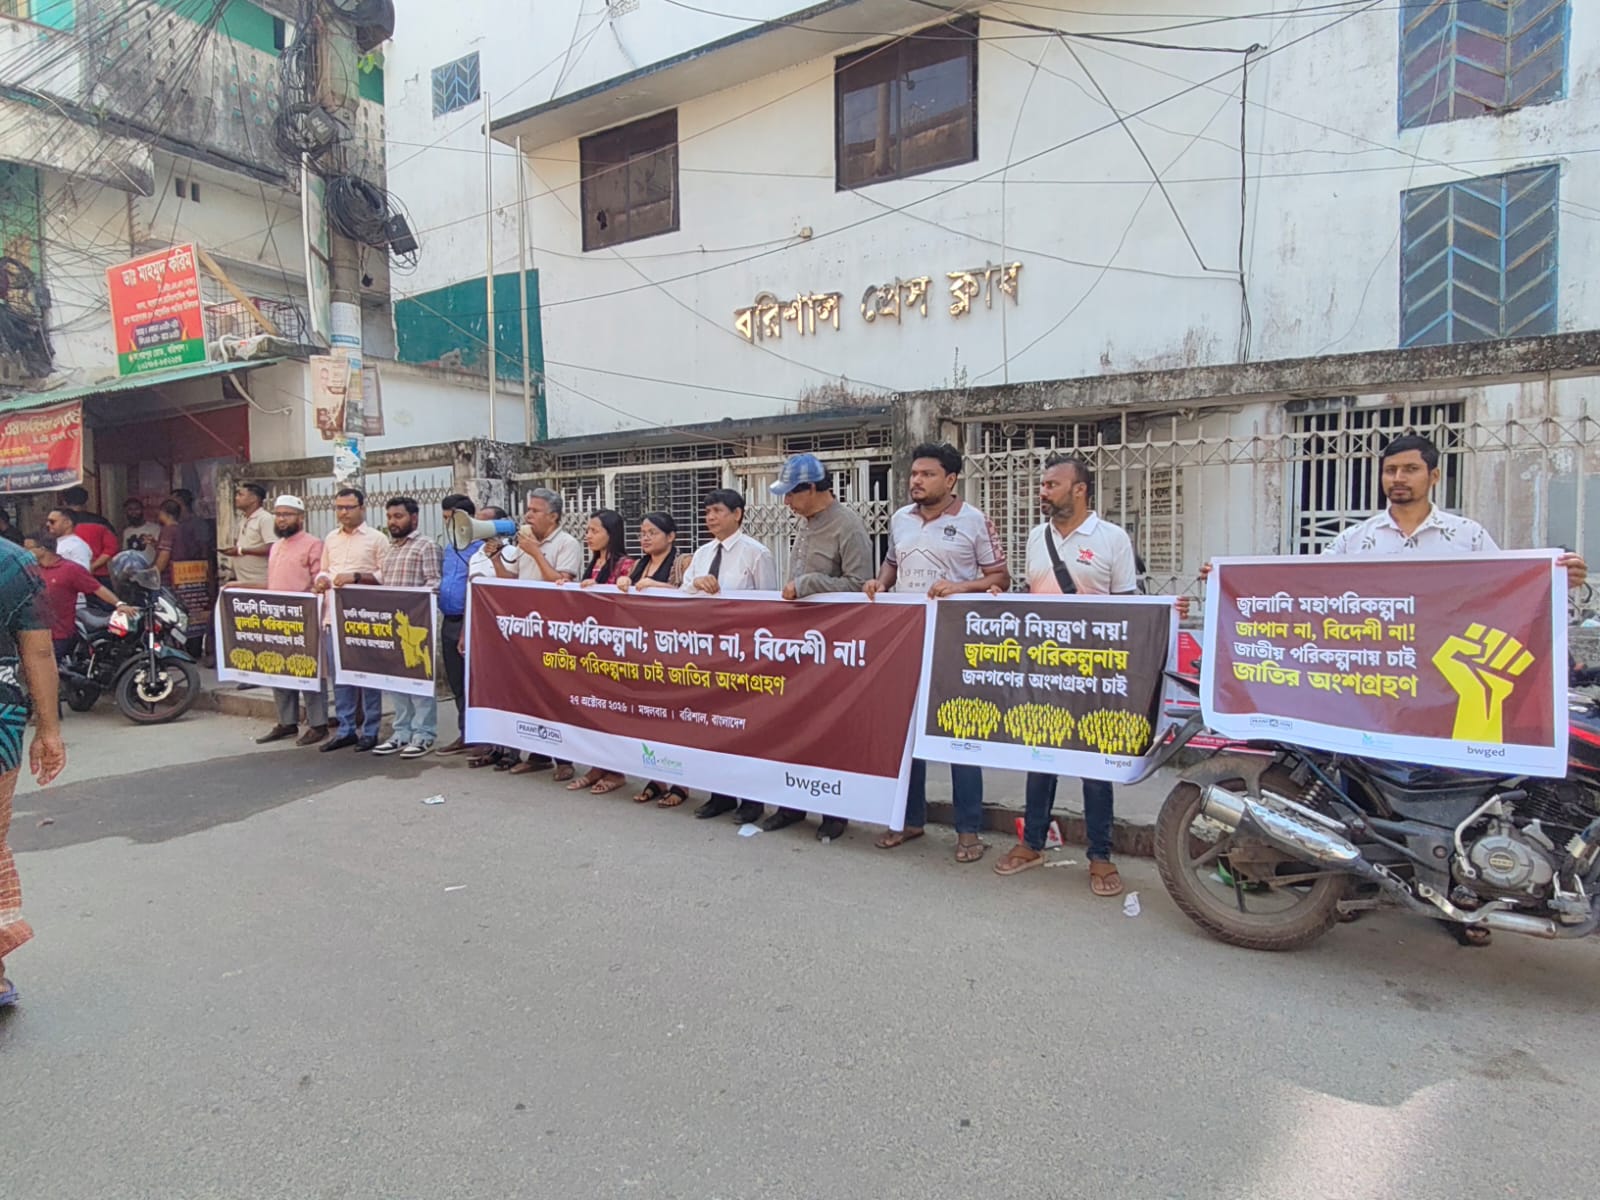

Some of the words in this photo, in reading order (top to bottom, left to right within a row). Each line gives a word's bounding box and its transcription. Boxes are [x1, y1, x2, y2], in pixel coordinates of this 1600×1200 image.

[733, 289, 843, 344] বরিশাল
[860, 275, 932, 325] প্রেস
[946, 260, 1024, 320] ক্লাব
[1236, 591, 1293, 619] জ্বালানি
[1299, 591, 1415, 621] মহাপরিকল্পনা
[496, 610, 543, 642] জ্বালানি
[548, 615, 648, 658] মহাপরিকল্পনা;
[655, 628, 713, 657] জাপান
[719, 632, 747, 662] না,
[754, 628, 827, 665] বিদেশী
[834, 639, 867, 667] না!
[965, 611, 1021, 637] বিদেশি
[1025, 612, 1087, 643] নিয়ন্ত্রণ
[1092, 620, 1129, 641] নয়!
[1235, 619, 1288, 639] জাপান
[1293, 622, 1317, 642] না,
[1323, 617, 1383, 641] বিদেশী
[1388, 621, 1416, 642] না!
[542, 647, 577, 672] জাতীয়
[579, 650, 640, 683] পরিকল্পনায়
[643, 660, 665, 684] চাই
[669, 661, 710, 689] জাতির
[716, 670, 786, 696] অংশগ্রহণ
[964, 638, 1022, 669] জ্বালানি
[1027, 641, 1130, 676] পরিকল্পনায়
[1233, 640, 1284, 661] জাতীয়
[1290, 643, 1380, 672] পরিকল্পনায়
[1387, 645, 1416, 669] চাই
[962, 669, 1024, 688] জনগণের
[1029, 672, 1097, 694] অংশগ্রহণ
[1102, 674, 1129, 696] চাই
[1232, 659, 1300, 688] জাতির
[1308, 672, 1418, 700] অংশগ্রহণ
[679, 706, 709, 726] বরিশাল,
[711, 714, 747, 730] বাংলাদেশ
[1104, 757, 1132, 768] bwged
[1467, 745, 1506, 758] bwged
[785, 771, 843, 798] bwged
